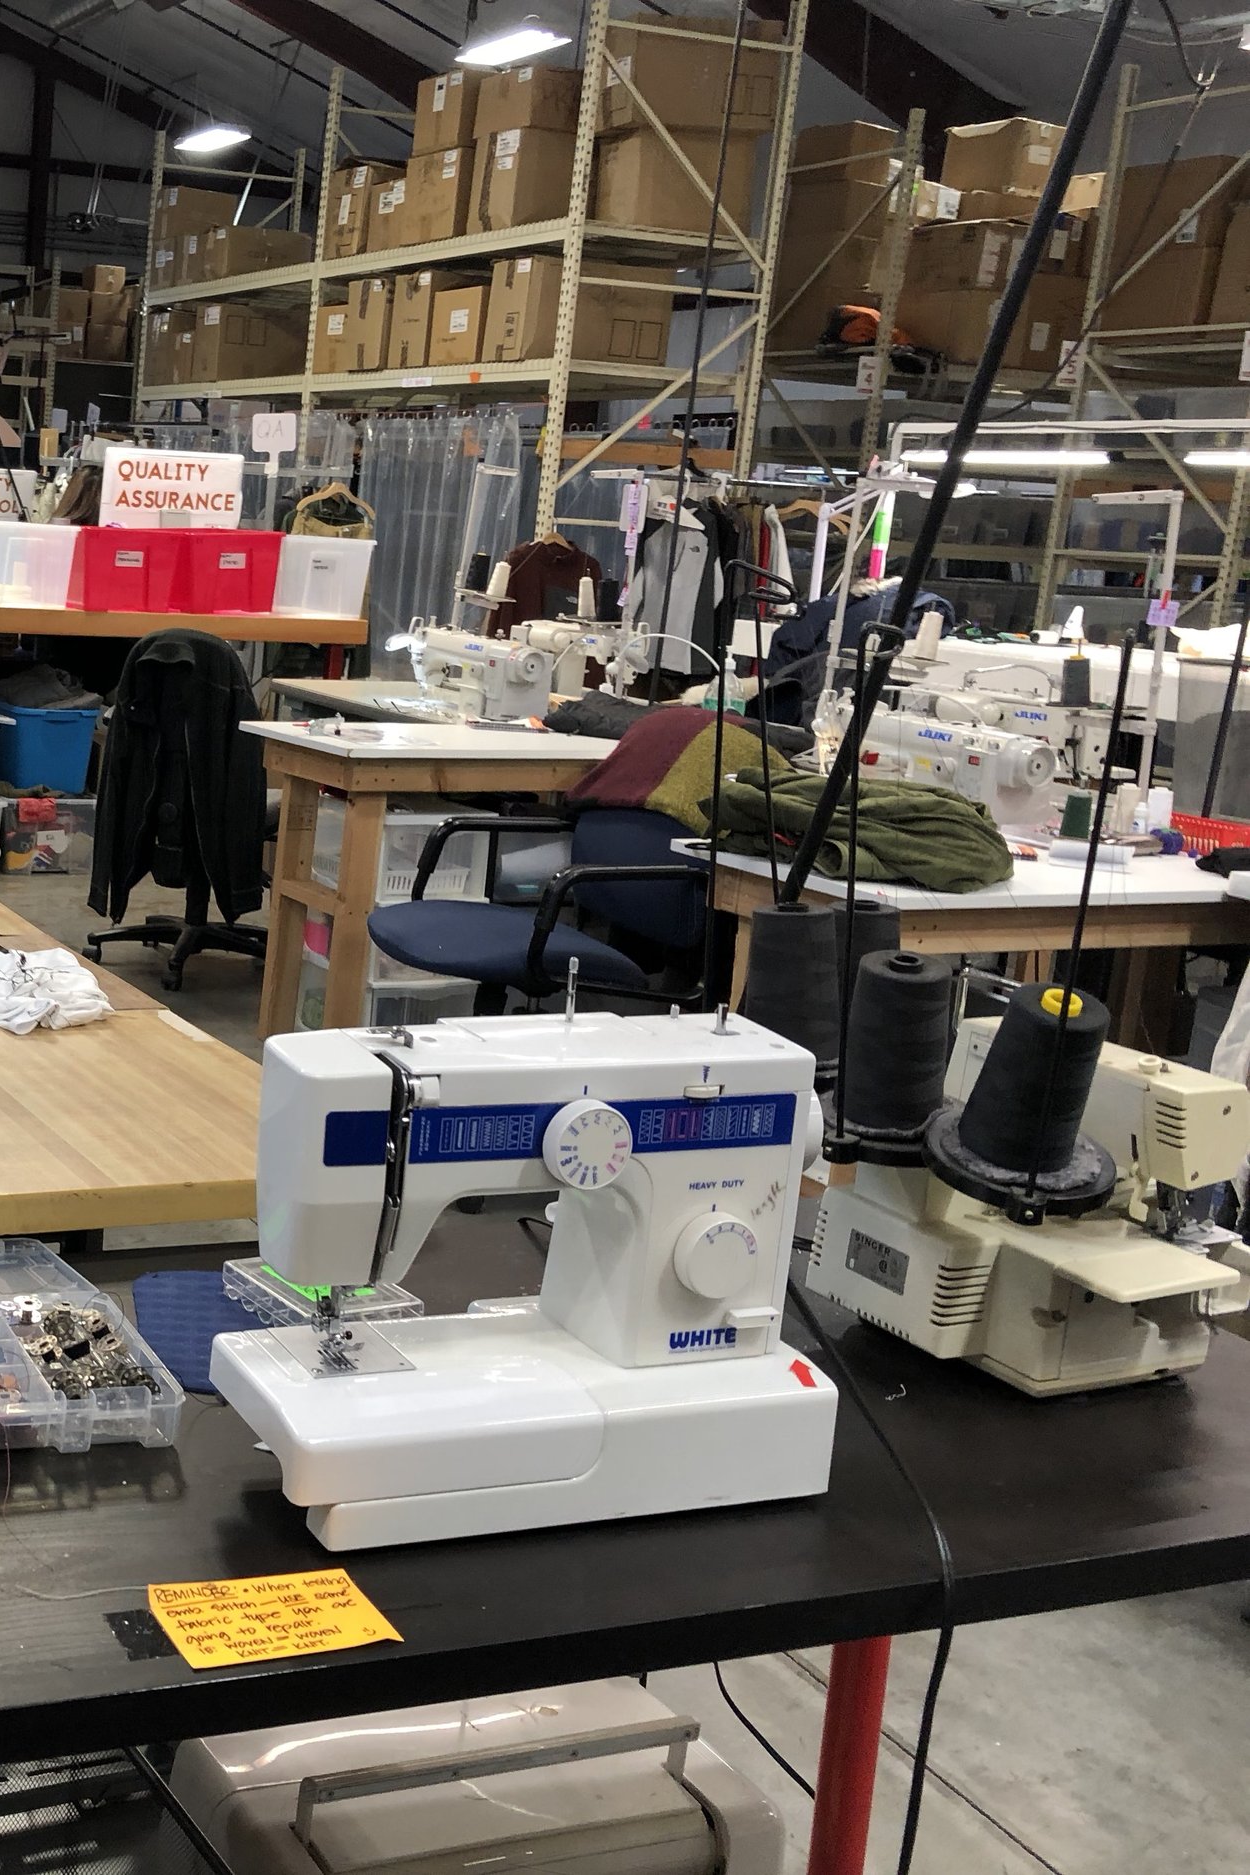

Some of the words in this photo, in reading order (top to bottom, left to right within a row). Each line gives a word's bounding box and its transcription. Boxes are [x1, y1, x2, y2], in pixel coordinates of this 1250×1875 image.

[255, 419, 284, 439] QA
[118, 460, 210, 482] QUALITY
[114, 489, 235, 511] ASSURANCE
[1014, 710, 1048, 722] JUKI
[918, 729, 953, 742] JUKI
[689, 1180, 717, 1190] HEAVY
[721, 1179, 744, 1189] DUTY
[669, 1327, 737, 1349] WHITE
[252, 1582, 296, 1594] When
[302, 1576, 350, 1589] testing
[176, 1616, 233, 1632] fabric
[241, 1611, 281, 1623] type
[292, 1606, 324, 1619] you
[332, 1599, 357, 1609] are
[211, 1600, 257, 1611] stitch
[186, 1631, 231, 1646] going
[236, 1626, 257, 1635] to
[224, 1637, 274, 1649] WOVEN
[294, 1625, 342, 1640] WOVEN
[236, 1647, 270, 1658] KNIT
